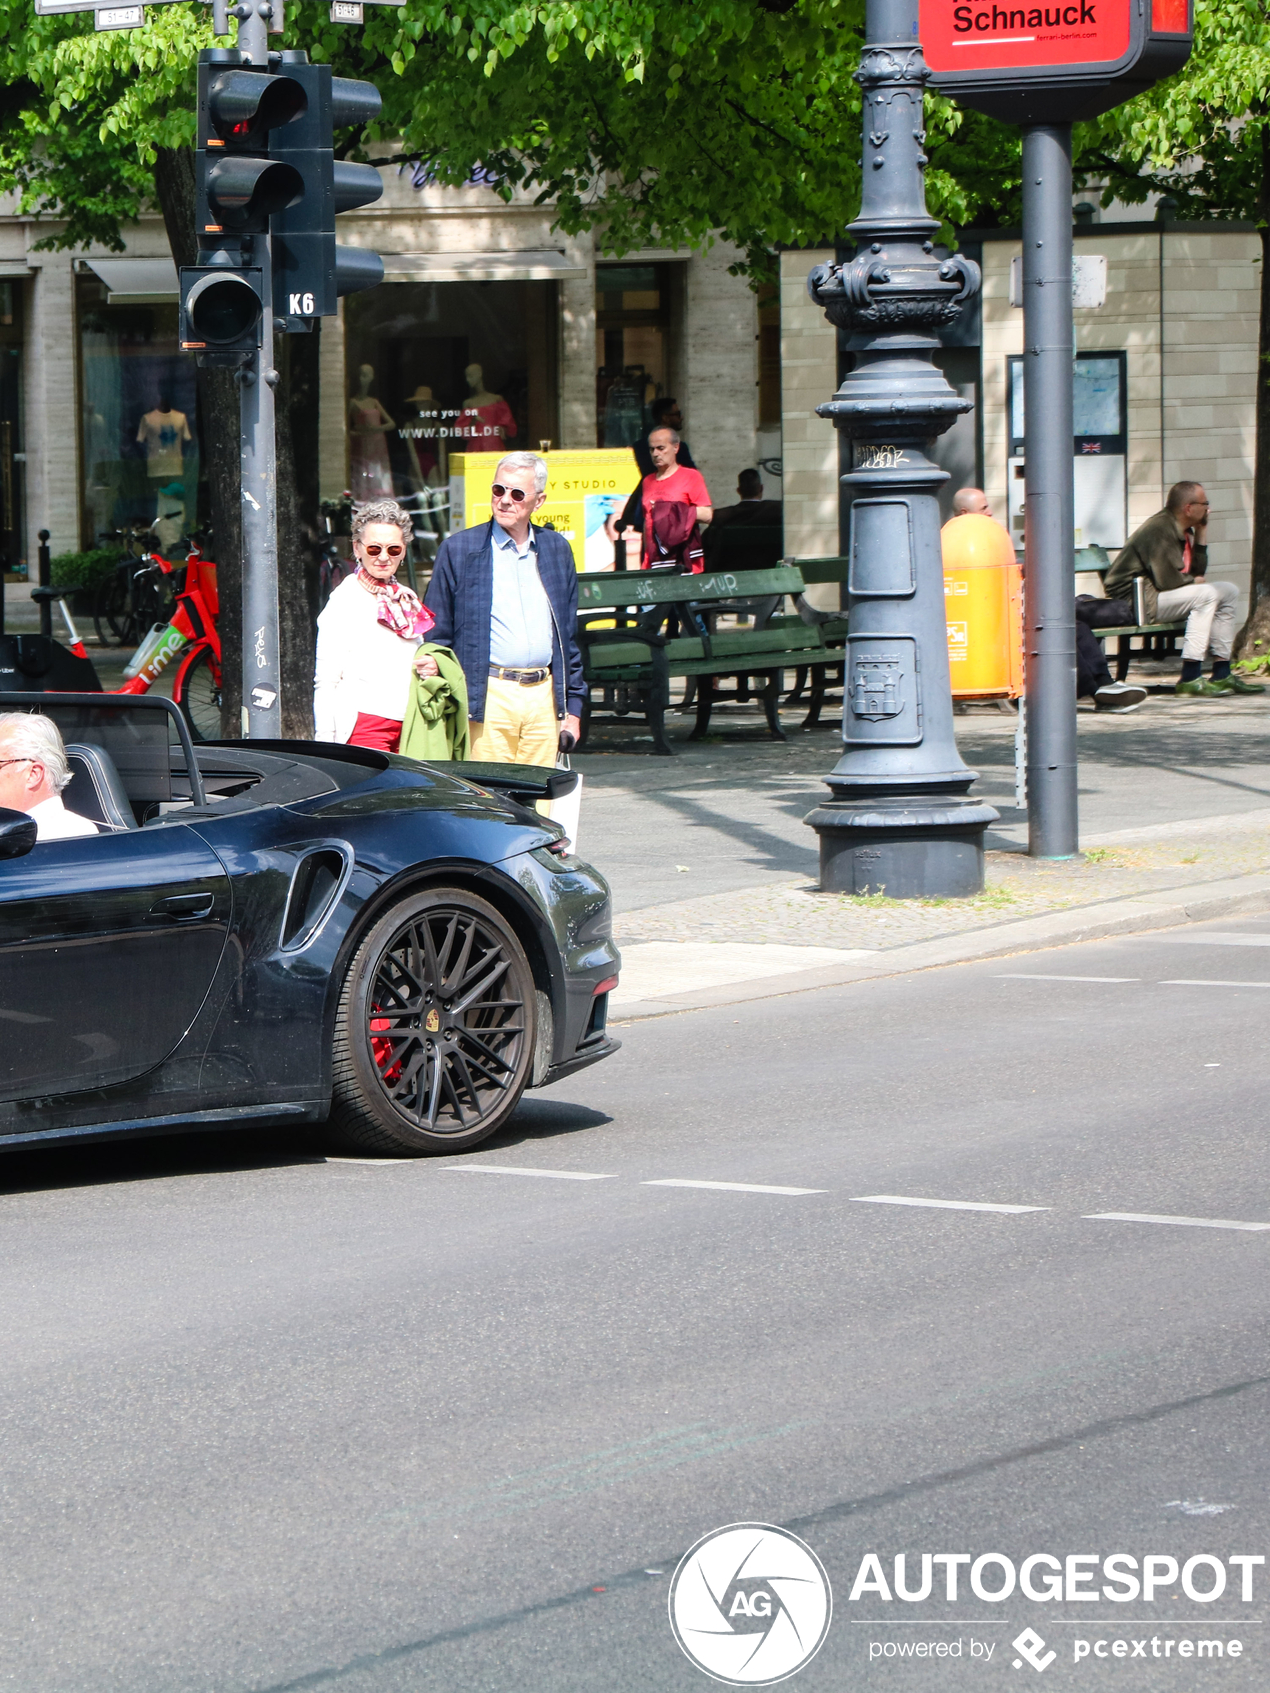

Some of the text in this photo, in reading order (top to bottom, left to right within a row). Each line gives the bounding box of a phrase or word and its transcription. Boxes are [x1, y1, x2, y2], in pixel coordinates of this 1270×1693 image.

[107, 11, 135, 23] 51-47
[952, 4, 1097, 33] Schnauck
[1036, 32, 1098, 42] ferrari-berlin.com
[289, 293, 315, 315] K6
[441, 411, 461, 420] you
[398, 426, 500, 439] WWW.DIBEL.DE
[563, 480, 617, 489] STUDIO
[536, 514, 571, 524] young
[139, 632, 183, 685] Lime
